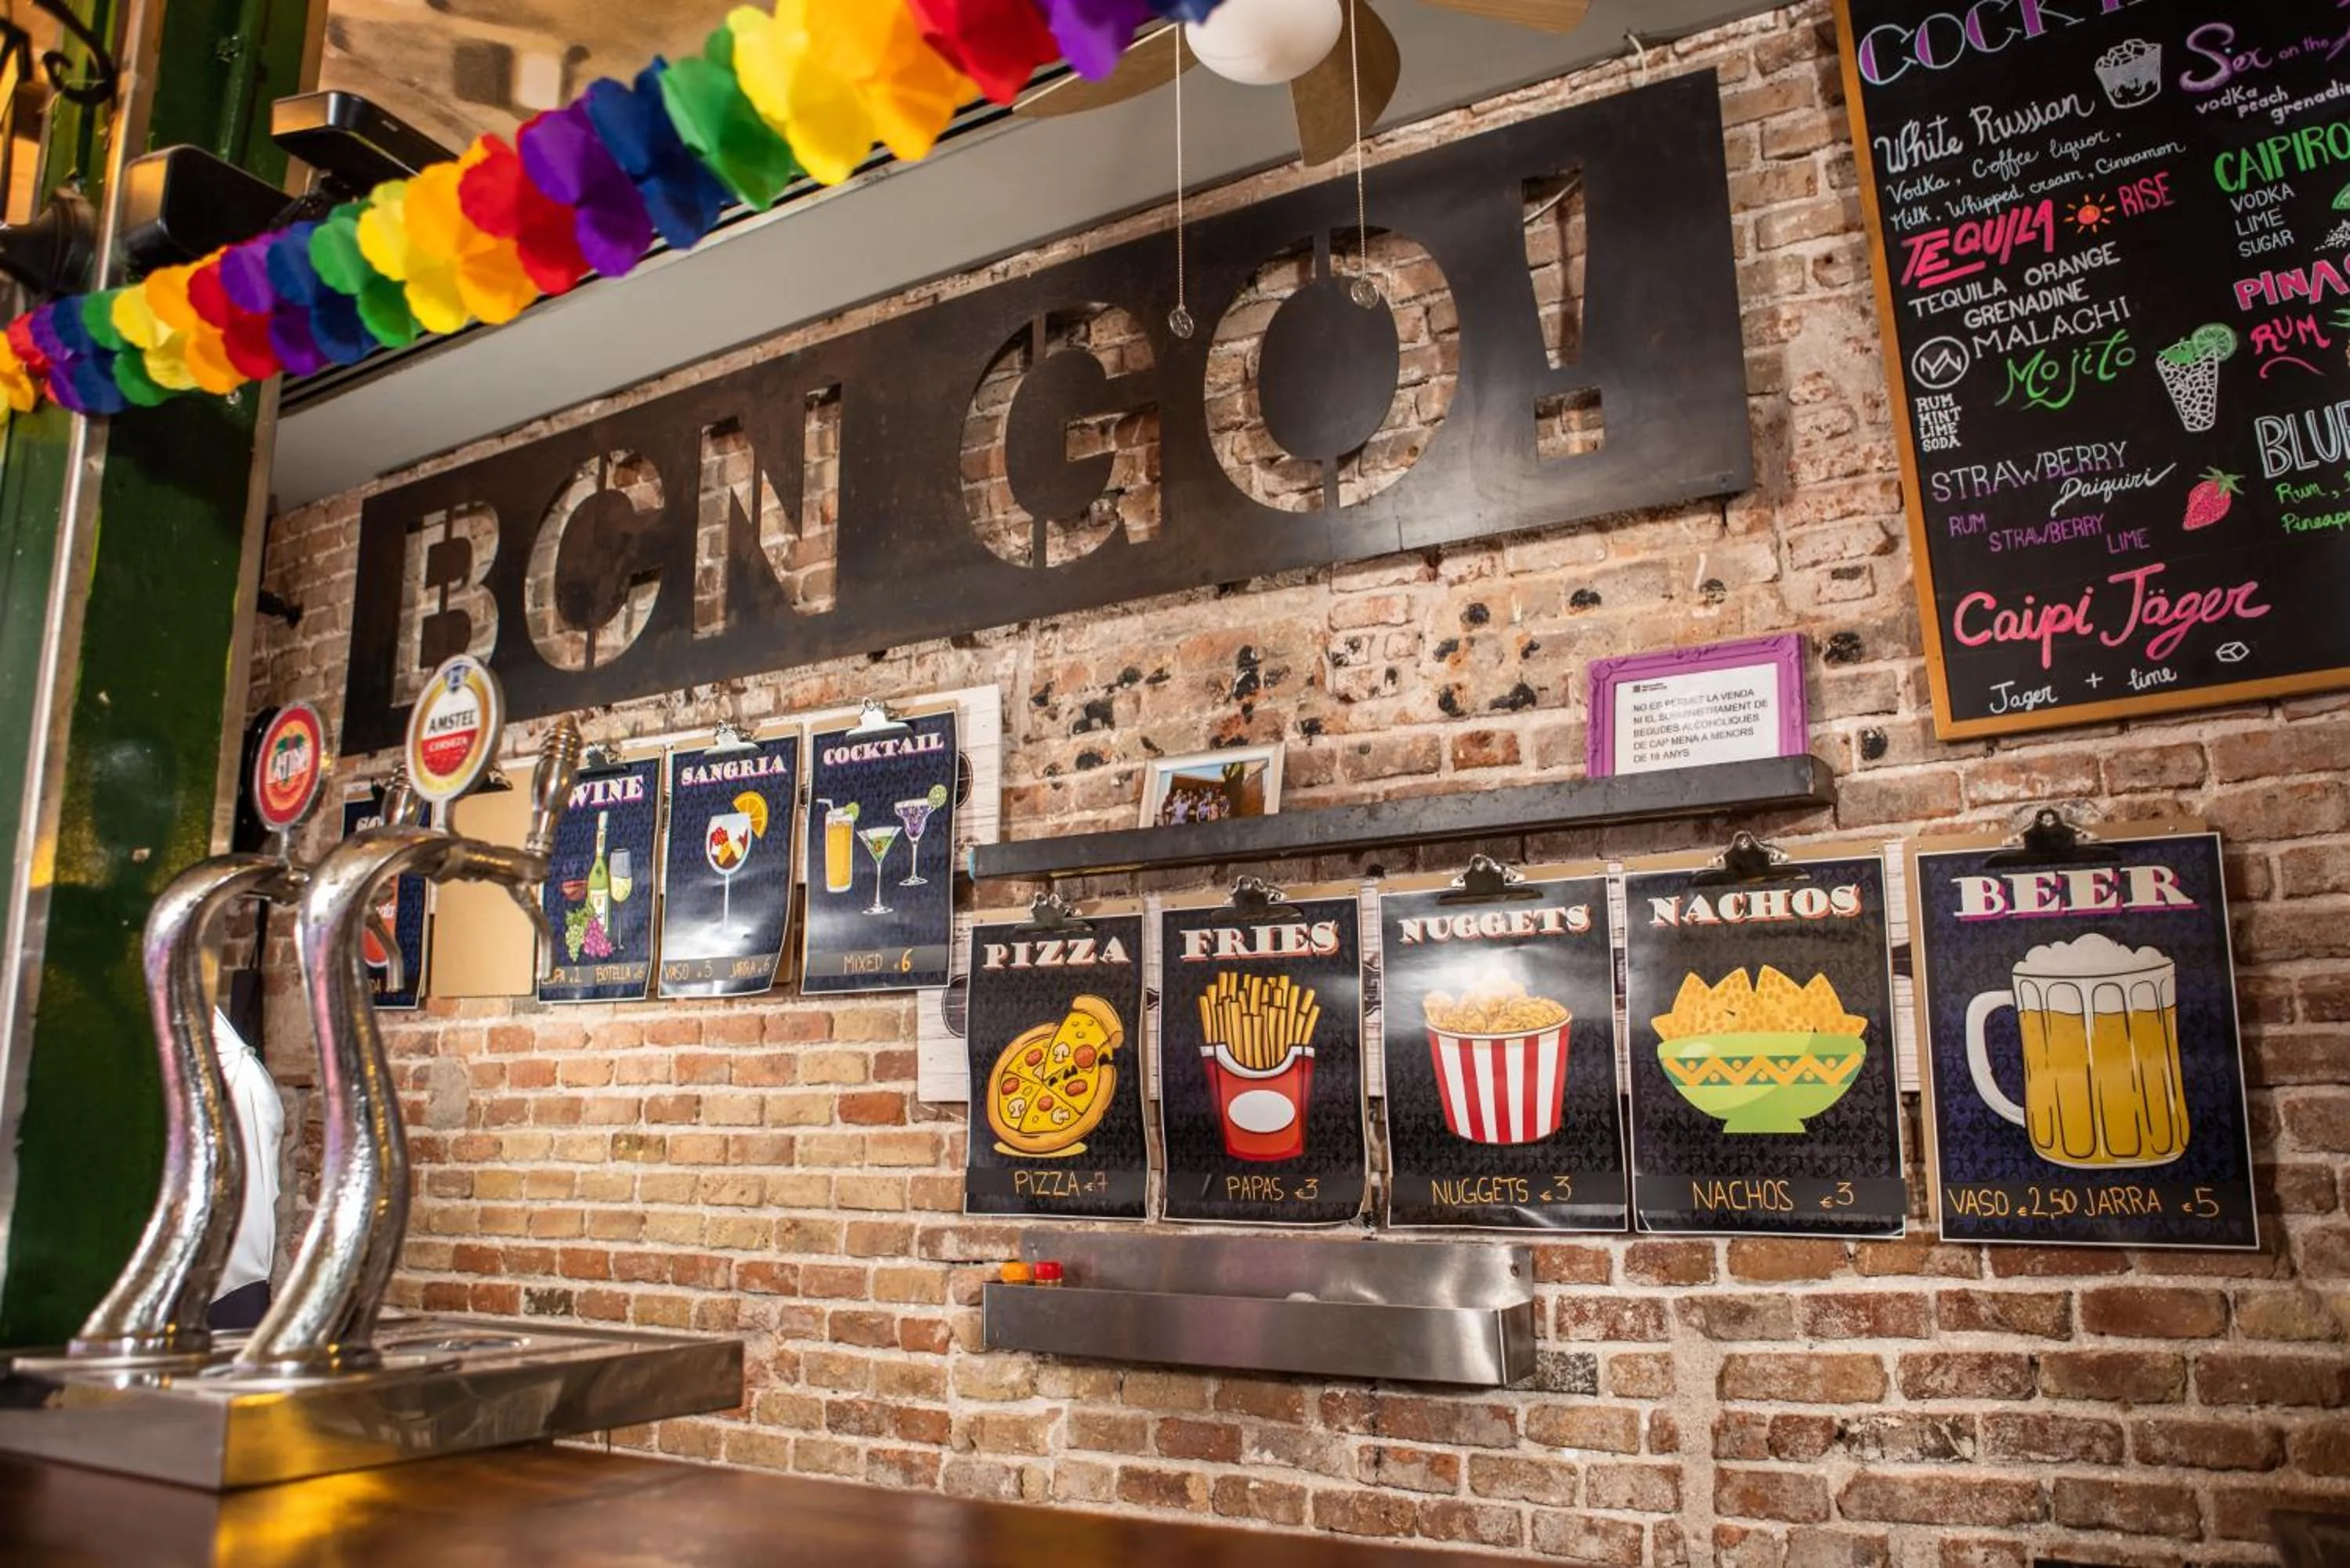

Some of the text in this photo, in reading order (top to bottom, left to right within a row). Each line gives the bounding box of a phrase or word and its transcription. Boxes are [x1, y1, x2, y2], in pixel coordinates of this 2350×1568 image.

[1858, 0, 2142, 85] COCK
[2178, 22, 2272, 92] Sex
[2279, 45, 2300, 60] on
[2303, 36, 2330, 52] the
[2237, 85, 2289, 118] peach
[1874, 94, 2095, 174] White Russian
[1944, 184, 2025, 218] Whipped
[2095, 142, 2186, 174] Cinnamon
[1972, 147, 2039, 182] Coffee
[2230, 182, 2295, 214] VODKA
[1900, 172, 2176, 287] TEQUILA RISE
[2235, 205, 2286, 236] LIME
[2238, 229, 2295, 258] SUGAR
[1907, 240, 2121, 316] TEQUILA ORANGE
[1964, 278, 2090, 330] GRENADINE
[1972, 296, 2131, 359] MALACHI
[2250, 314, 2331, 356] RUM
[1994, 329, 2136, 410] Mojito
[1916, 393, 1956, 413] RUM
[1918, 406, 1962, 427] MINT
[390, 161, 1607, 708] BCN GO!
[1919, 421, 1958, 440] LIME
[1922, 435, 1961, 453] SODA
[1931, 440, 2128, 502] STRAWBERRY
[2050, 463, 2176, 518] Daiquiri
[1949, 513, 2151, 555] RUM STRAWBERRY LIME
[1953, 562, 2272, 670] Caipi Jäger
[1706, 694, 1719, 703] LA
[1721, 688, 1755, 700] VENDA
[1754, 699, 1768, 709] DE
[1989, 680, 2059, 714] Jager
[2128, 667, 2178, 691] lime
[823, 732, 945, 766] COCKTAIL
[1633, 742, 1647, 750] DE
[1671, 735, 1700, 746] MENA
[1701, 734, 1708, 742] A
[1710, 728, 1754, 740] MENORS
[1663, 749, 1690, 760] ANYS
[680, 754, 787, 785] SANGRIA
[569, 775, 643, 809] WINE
[1647, 883, 1863, 927] NACHOS
[1950, 865, 2200, 922] BEER
[1180, 919, 1340, 962] FRIES
[1398, 903, 1593, 945] NUGGETS
[843, 953, 883, 974] MIXED
[982, 936, 1132, 970] PIZZA
[663, 963, 689, 981] VASO
[1014, 1169, 1081, 1198] PIZZA
[1226, 1176, 1285, 1201] PAPAS
[1431, 1176, 1529, 1205] NUGGETS
[1692, 1180, 1794, 1212] NACHOS
[1947, 1188, 2009, 1217] VASO
[2084, 1187, 2162, 1217] JARRA
